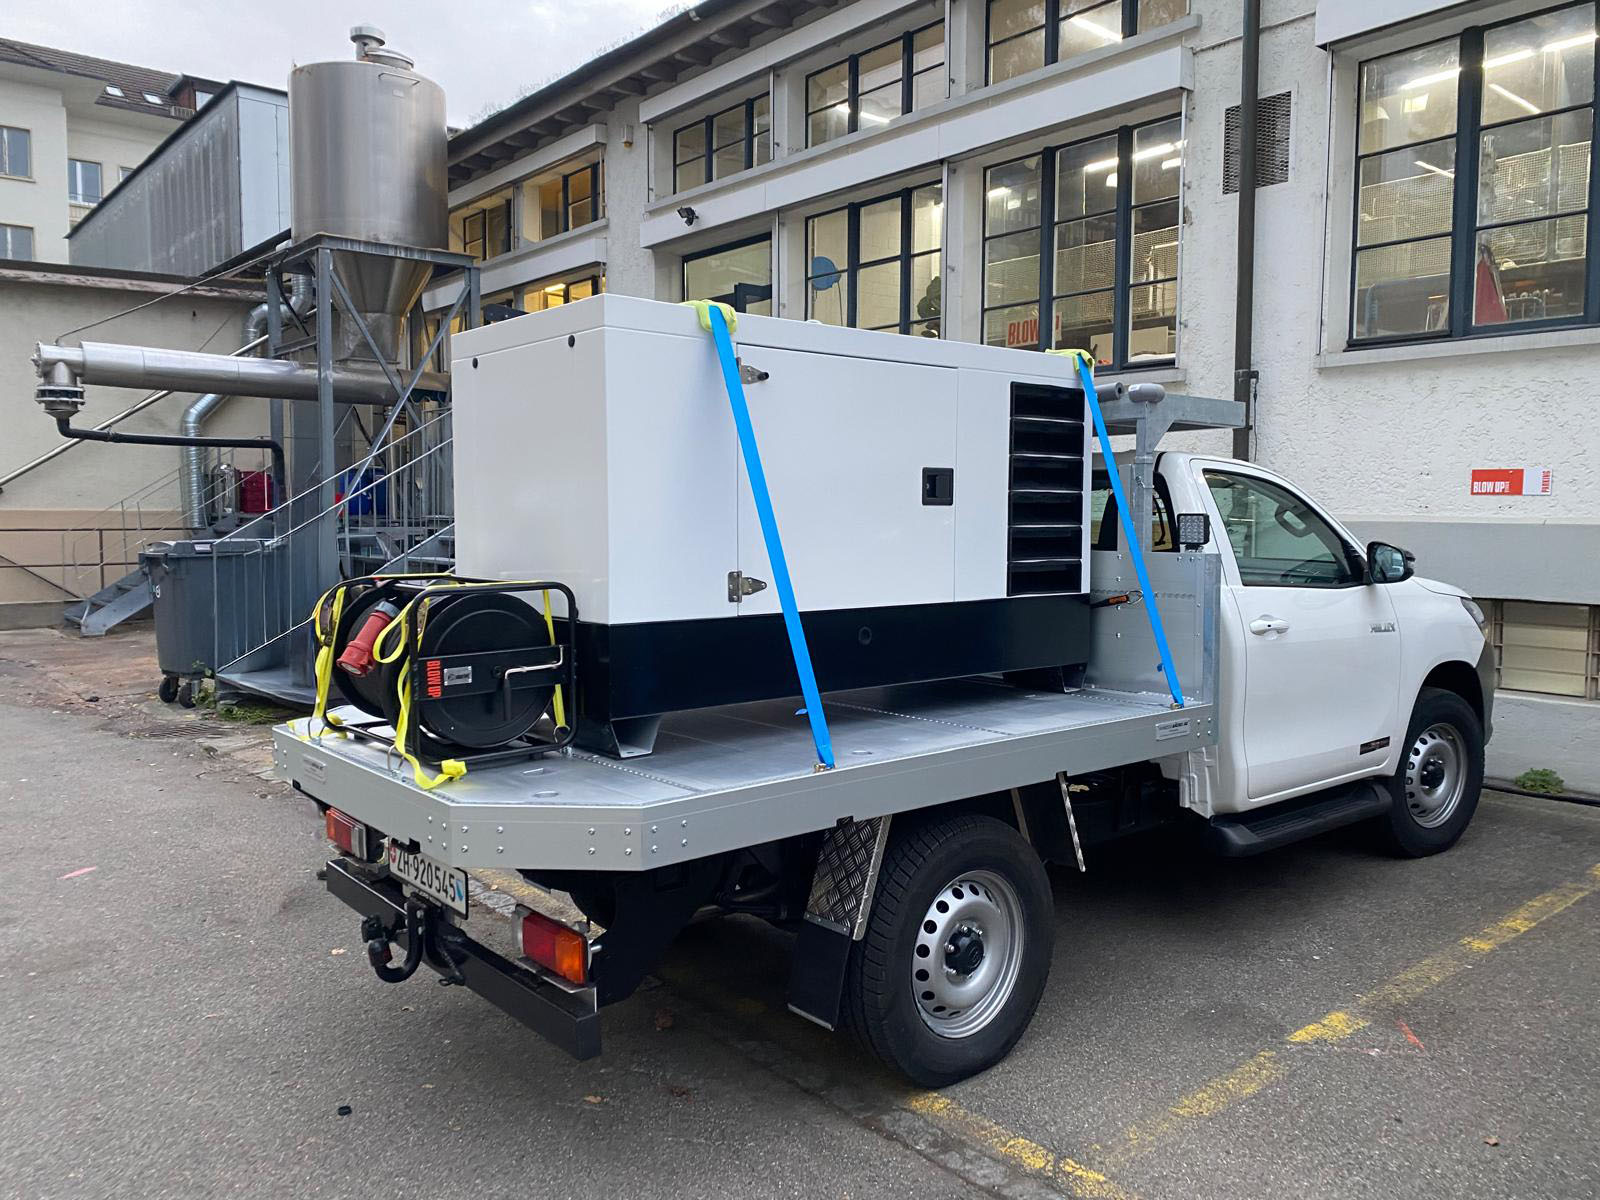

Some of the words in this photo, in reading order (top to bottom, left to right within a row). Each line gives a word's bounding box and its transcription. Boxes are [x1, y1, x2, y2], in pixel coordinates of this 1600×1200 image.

[1008, 320, 1038, 345] BLOW
[1473, 481, 1494, 493] BLOW
[1495, 481, 1505, 493] UP
[428, 686, 441, 697] UP
